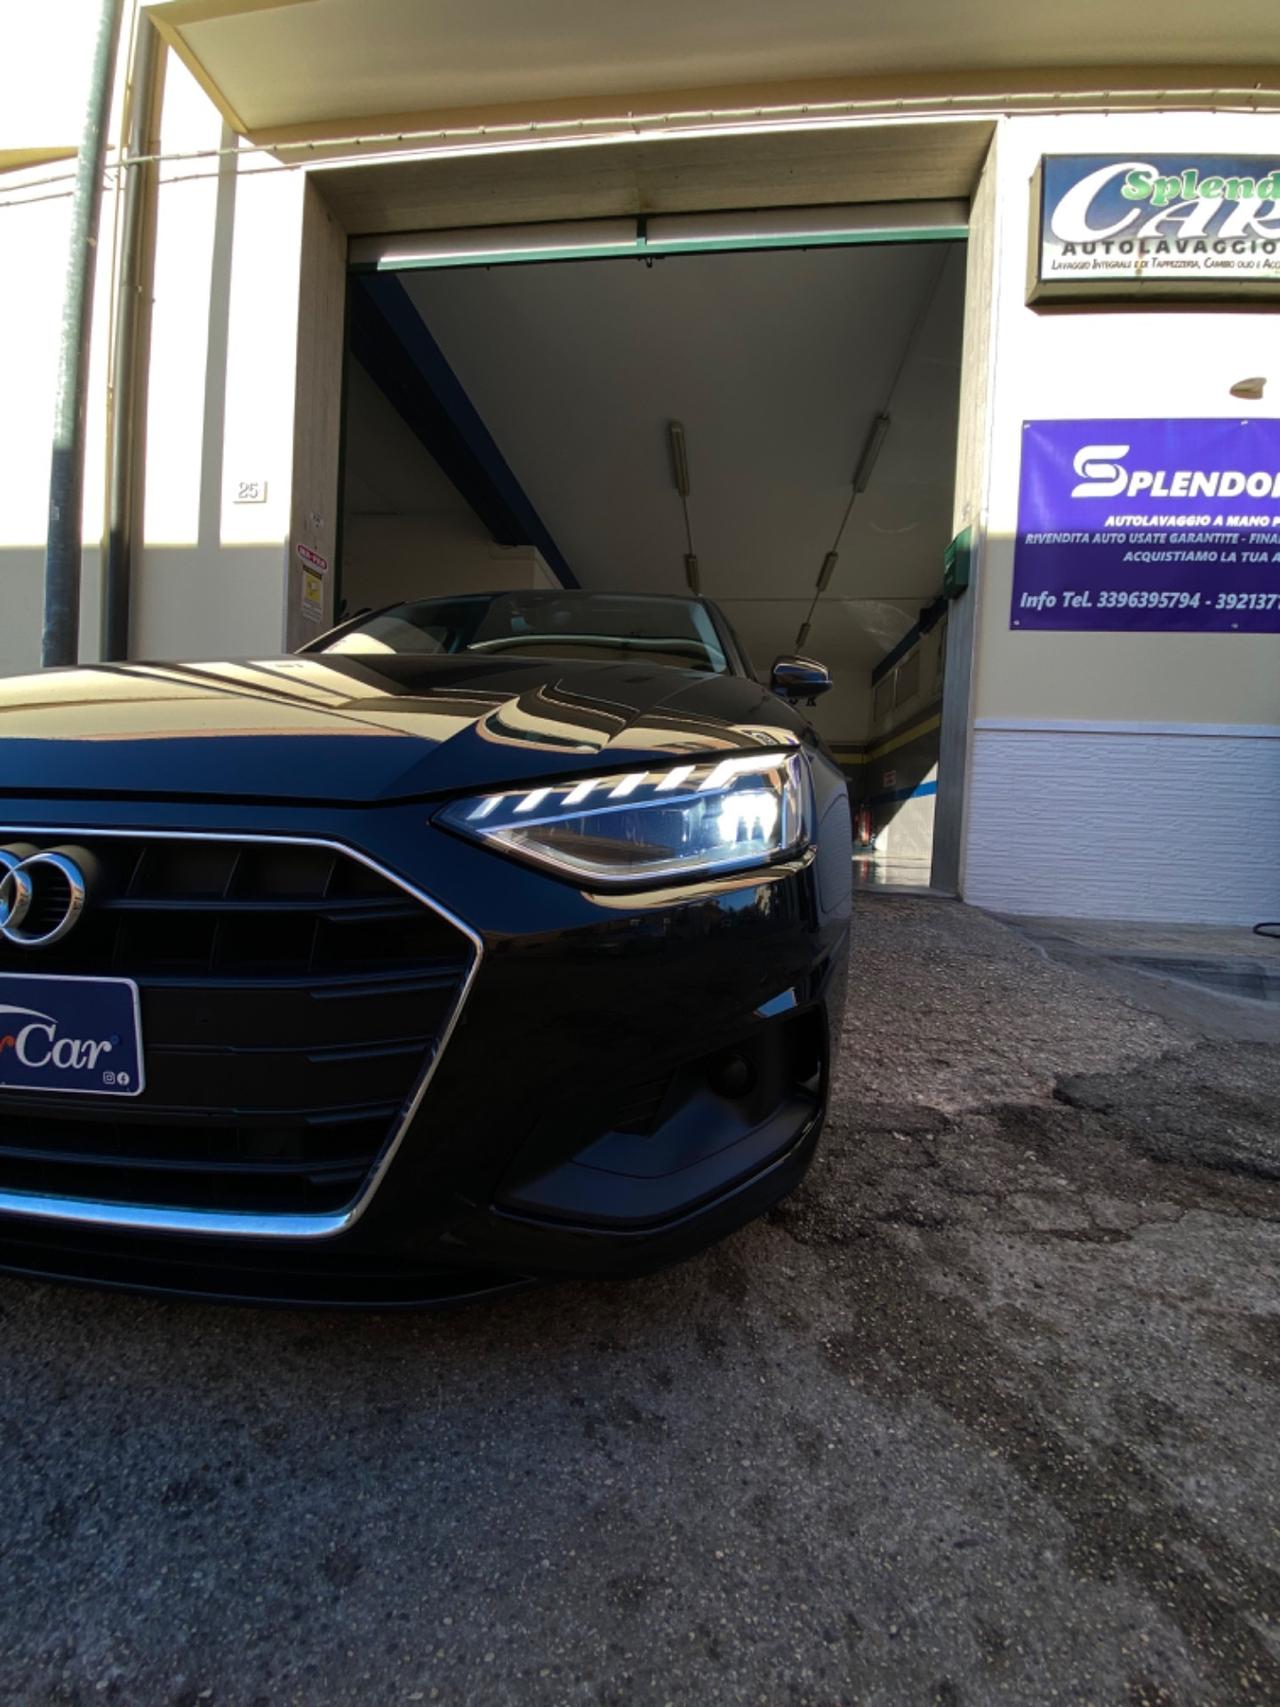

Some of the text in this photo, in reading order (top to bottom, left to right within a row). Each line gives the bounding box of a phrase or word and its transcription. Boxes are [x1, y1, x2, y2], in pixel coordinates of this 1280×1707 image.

[1061, 240, 1277, 256] AUTOLAVAGGIO
[238, 481, 259, 499] 25
[1104, 515, 1211, 527] AUTOLAVAGGIO
[1213, 515, 1223, 526] A
[1226, 516, 1270, 527] MANO
[1025, 533, 1090, 544] RIVENDITA
[1091, 533, 1127, 544] AUTO
[1129, 533, 1167, 544] USATE
[1169, 533, 1239, 544] GARANTITE
[1122, 551, 1218, 563] ACQUISTIAMO
[1220, 552, 1237, 562] LA
[1241, 552, 1268, 562] TUA
[1020, 591, 1057, 610] Info
[1062, 591, 1092, 608] Tel.
[1096, 592, 1201, 608] 3396395794
[1215, 594, 1280, 610] 392137
